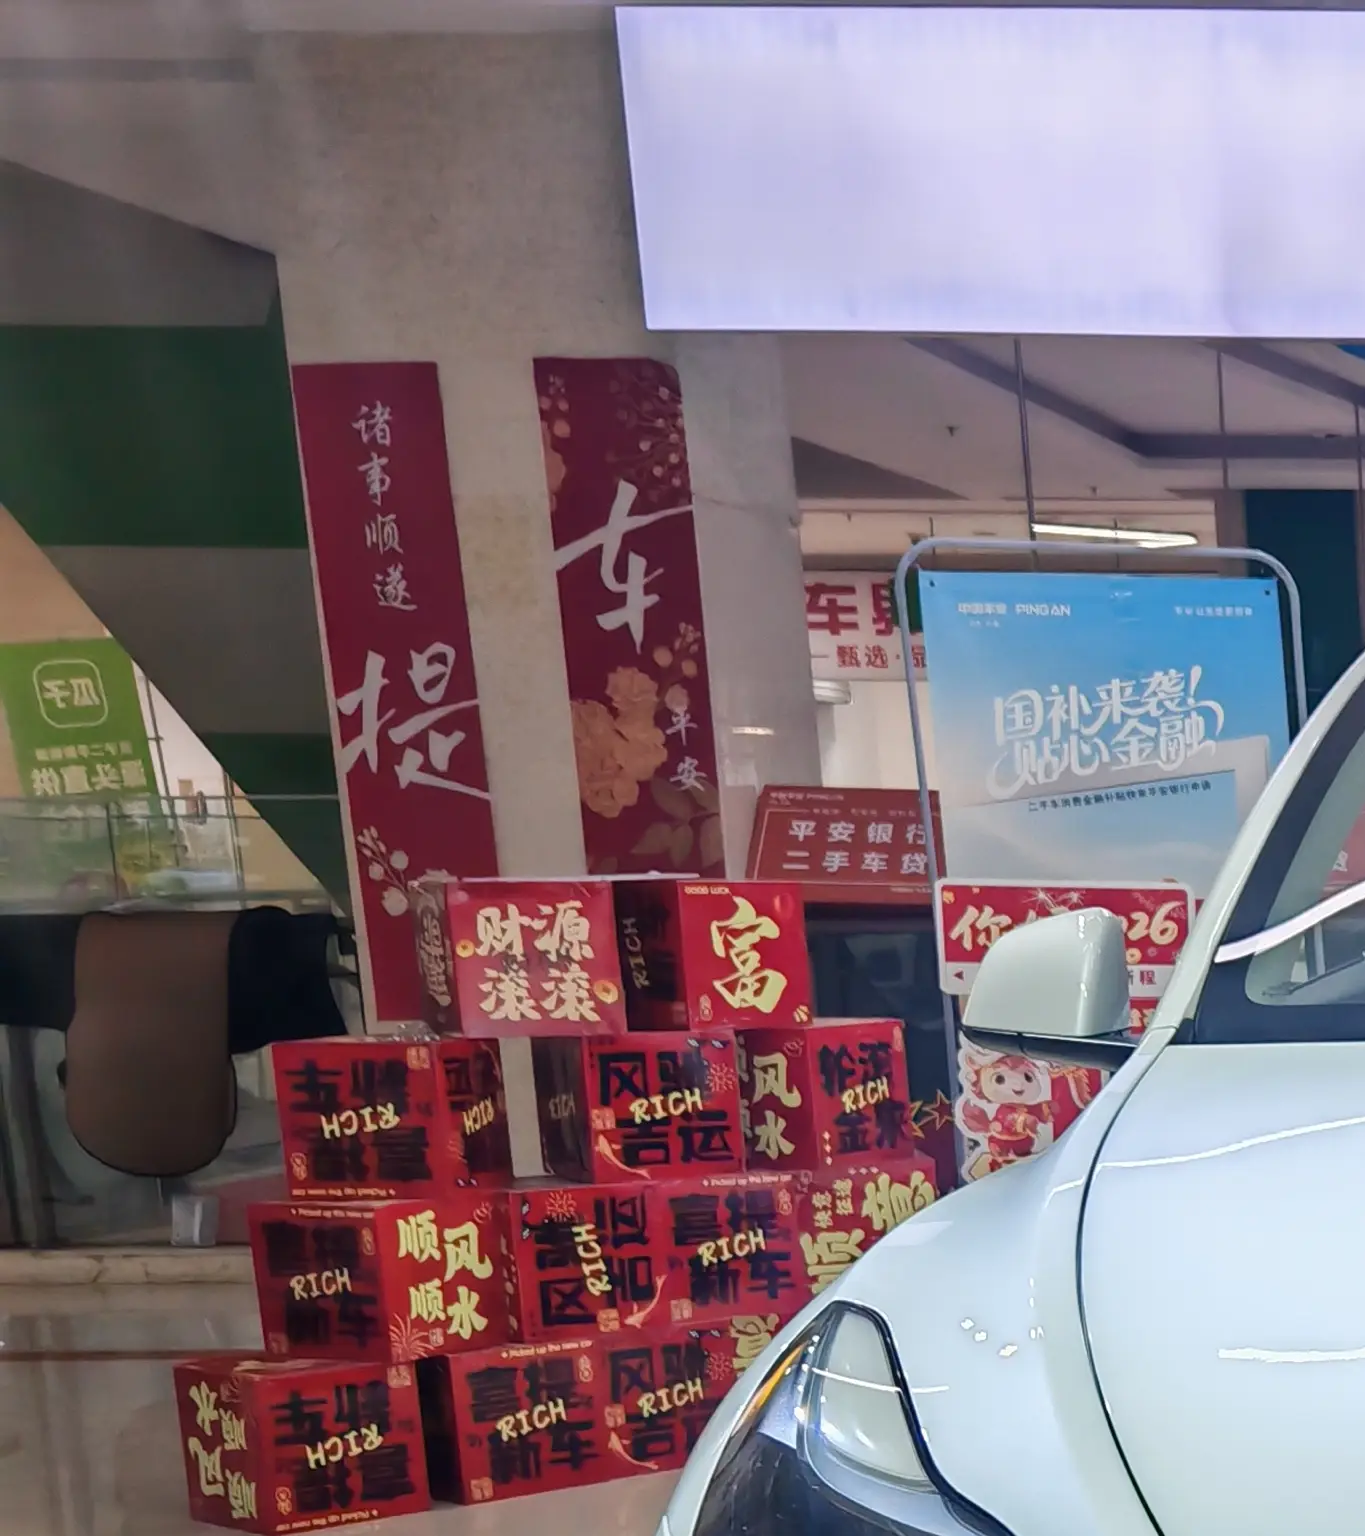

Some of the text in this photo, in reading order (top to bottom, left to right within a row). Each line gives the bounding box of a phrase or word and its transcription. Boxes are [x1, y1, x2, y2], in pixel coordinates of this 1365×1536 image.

[351, 402, 418, 612] 诸事顺遂
[554, 479, 693, 652] 车
[336, 641, 490, 800] 提
[986, 710, 1225, 800] 贴心金融
[788, 819, 927, 845] 平安银行
[782, 850, 928, 876] 二手车贷
[475, 899, 597, 962] 财源
[709, 895, 789, 1014] 富
[478, 960, 601, 1022] 滚滚
[320, 1102, 401, 1140] RICH
[629, 1086, 704, 1125] RICH
[840, 1075, 892, 1114] RICH
[396, 1209, 494, 1284] 顺风
[570, 1222, 613, 1298] RICH
[696, 1228, 767, 1268] RICH
[288, 1266, 353, 1301] RICH
[407, 1276, 489, 1341] 顺水
[495, 1397, 568, 1442] RICH
[637, 1377, 705, 1419] RICH
[304, 1422, 385, 1470] RICH
